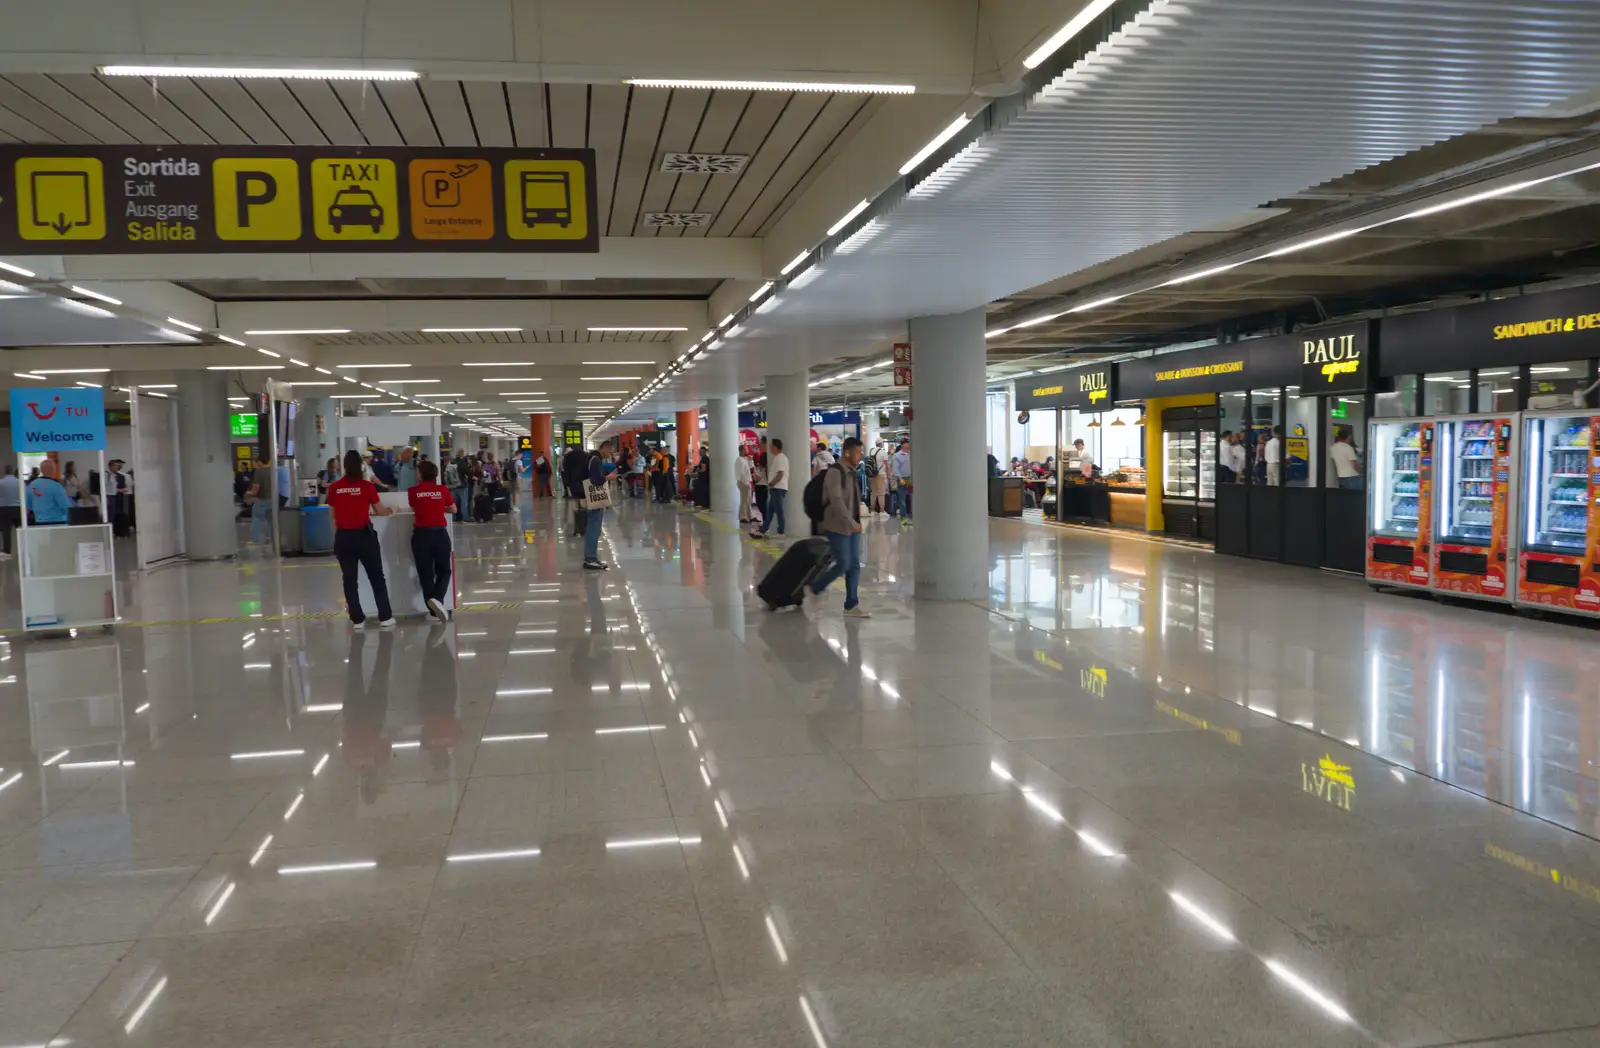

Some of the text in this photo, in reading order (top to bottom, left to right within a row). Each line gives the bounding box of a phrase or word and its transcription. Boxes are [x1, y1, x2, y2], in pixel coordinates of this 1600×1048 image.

[123, 157, 201, 177] Sortida
[328, 163, 379, 181] TAXI
[124, 180, 156, 197] Exit
[235, 170, 277, 227] P
[434, 179, 449, 199] P
[125, 200, 200, 220] Ausgang
[127, 221, 196, 241] Salida
[1493, 318, 1563, 340] SANDWICH
[1563, 318, 1576, 331] &
[1303, 334, 1360, 365] PAUL
[1210, 360, 1244, 375] CROISSANT
[1079, 372, 1107, 392] PAUL
[65, 407, 89, 417] TUI
[25, 431, 94, 443] Welcome
